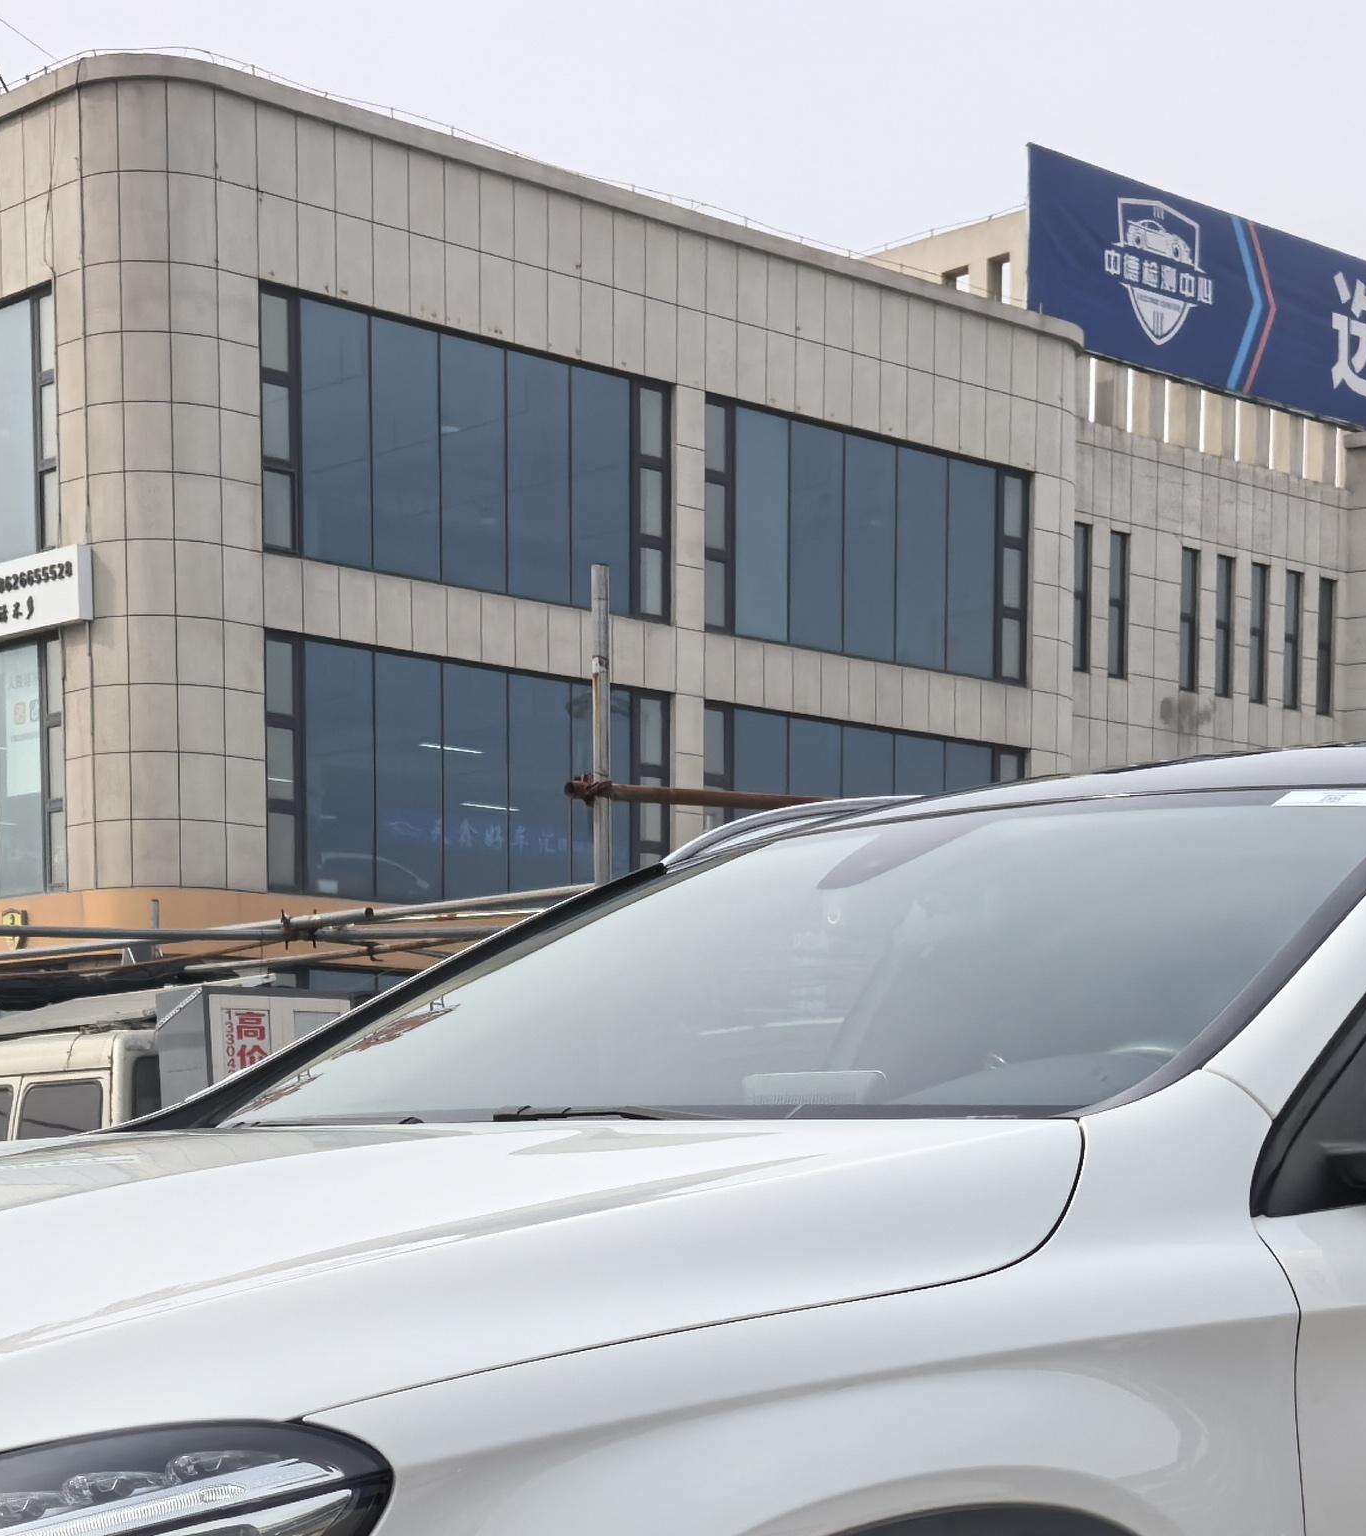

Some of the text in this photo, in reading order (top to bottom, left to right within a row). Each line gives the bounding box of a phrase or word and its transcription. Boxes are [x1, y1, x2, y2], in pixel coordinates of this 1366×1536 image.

[1103, 249, 1213, 305] 中德检测中心
[225, 1011, 236, 1074] 13304
